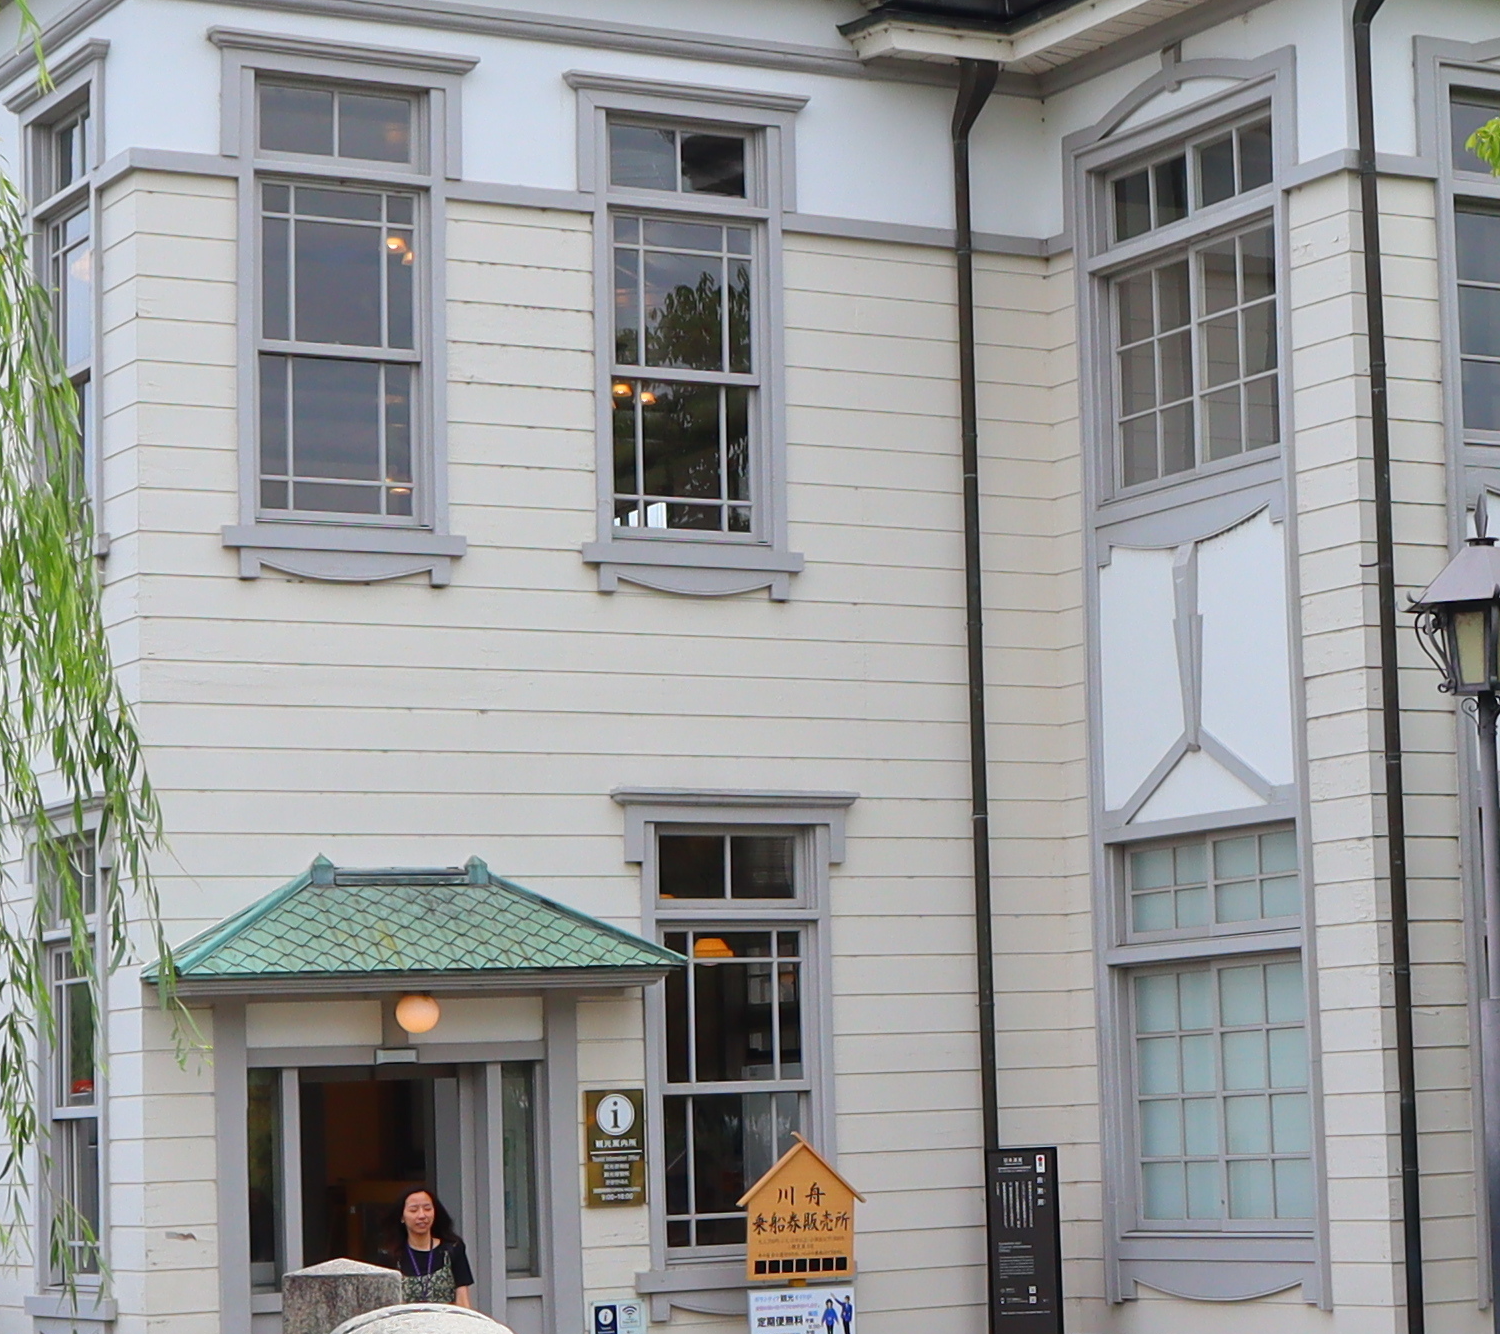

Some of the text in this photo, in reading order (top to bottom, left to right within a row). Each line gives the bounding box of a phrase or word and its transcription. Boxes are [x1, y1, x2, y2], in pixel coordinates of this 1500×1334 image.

[752, 1210, 850, 1235] 乗船券販売所
[757, 1315, 803, 1327] 定期便無料
